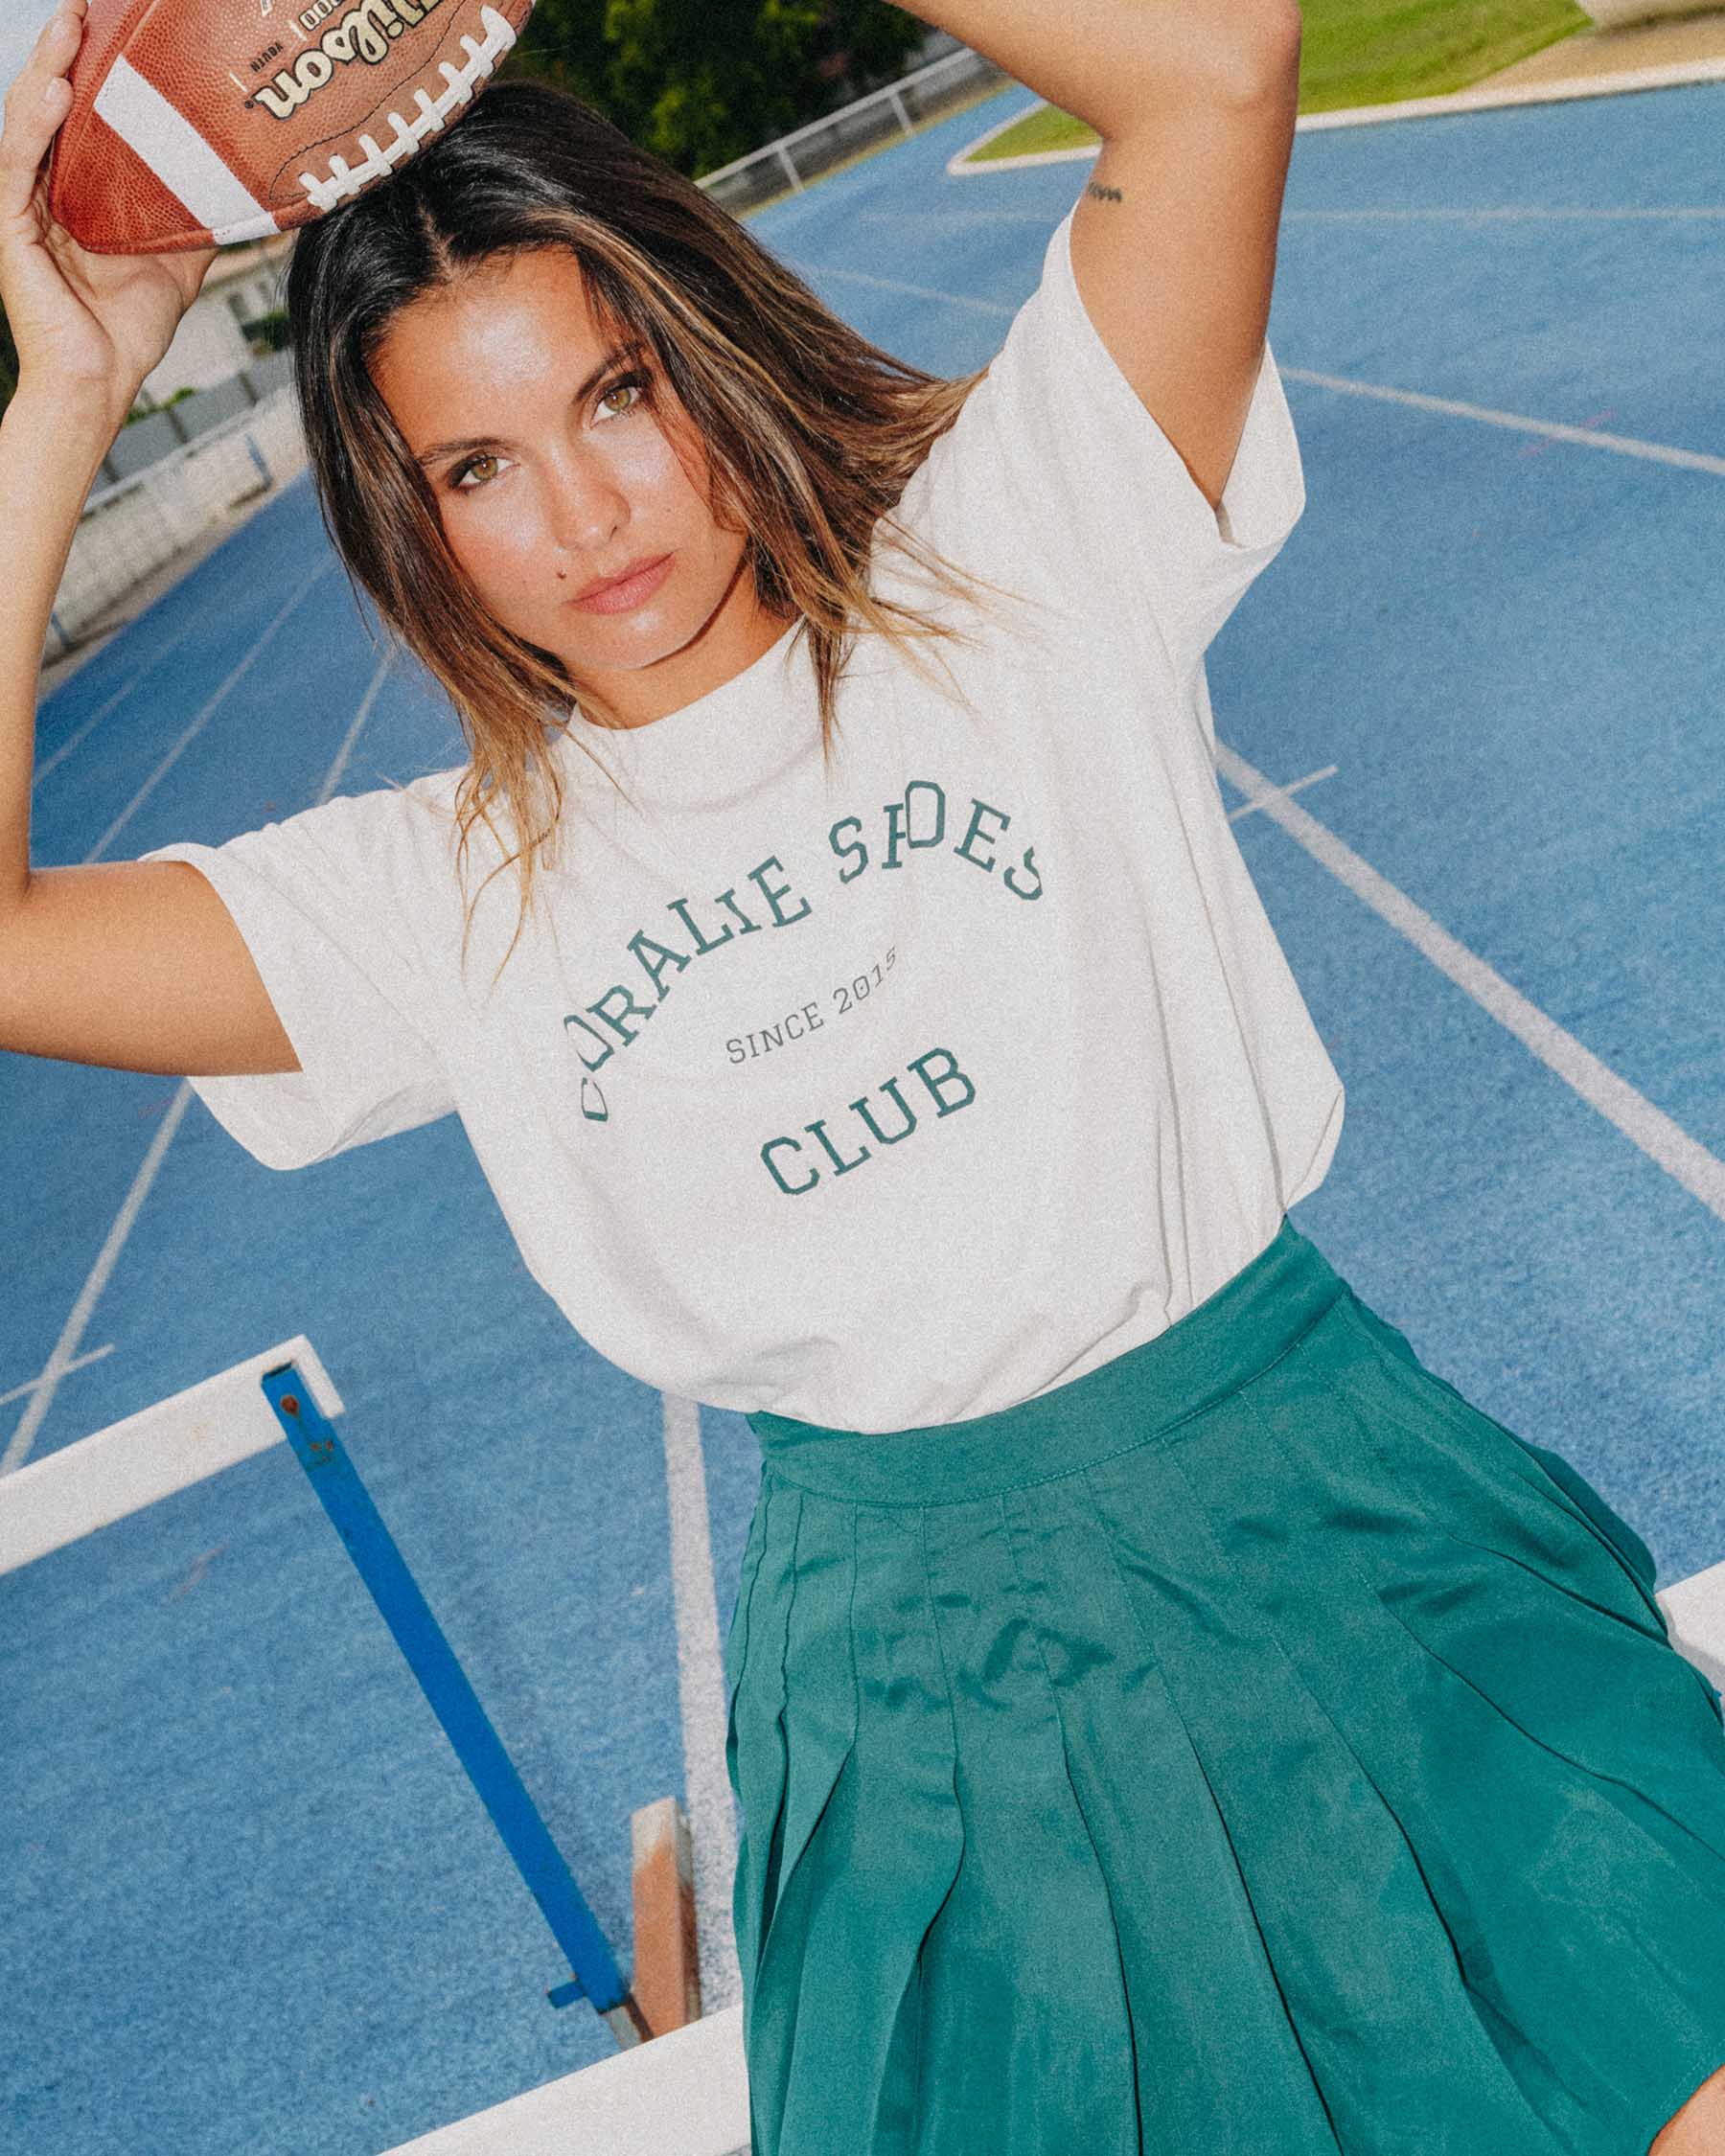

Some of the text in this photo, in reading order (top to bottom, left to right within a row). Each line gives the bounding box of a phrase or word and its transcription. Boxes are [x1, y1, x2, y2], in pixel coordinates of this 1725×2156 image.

[299, 0, 344, 31] 00
[250, 41, 284, 73] YOUTH
[725, 946, 896, 1064] SINCE 2015
[760, 1047, 976, 1195] CLUB
